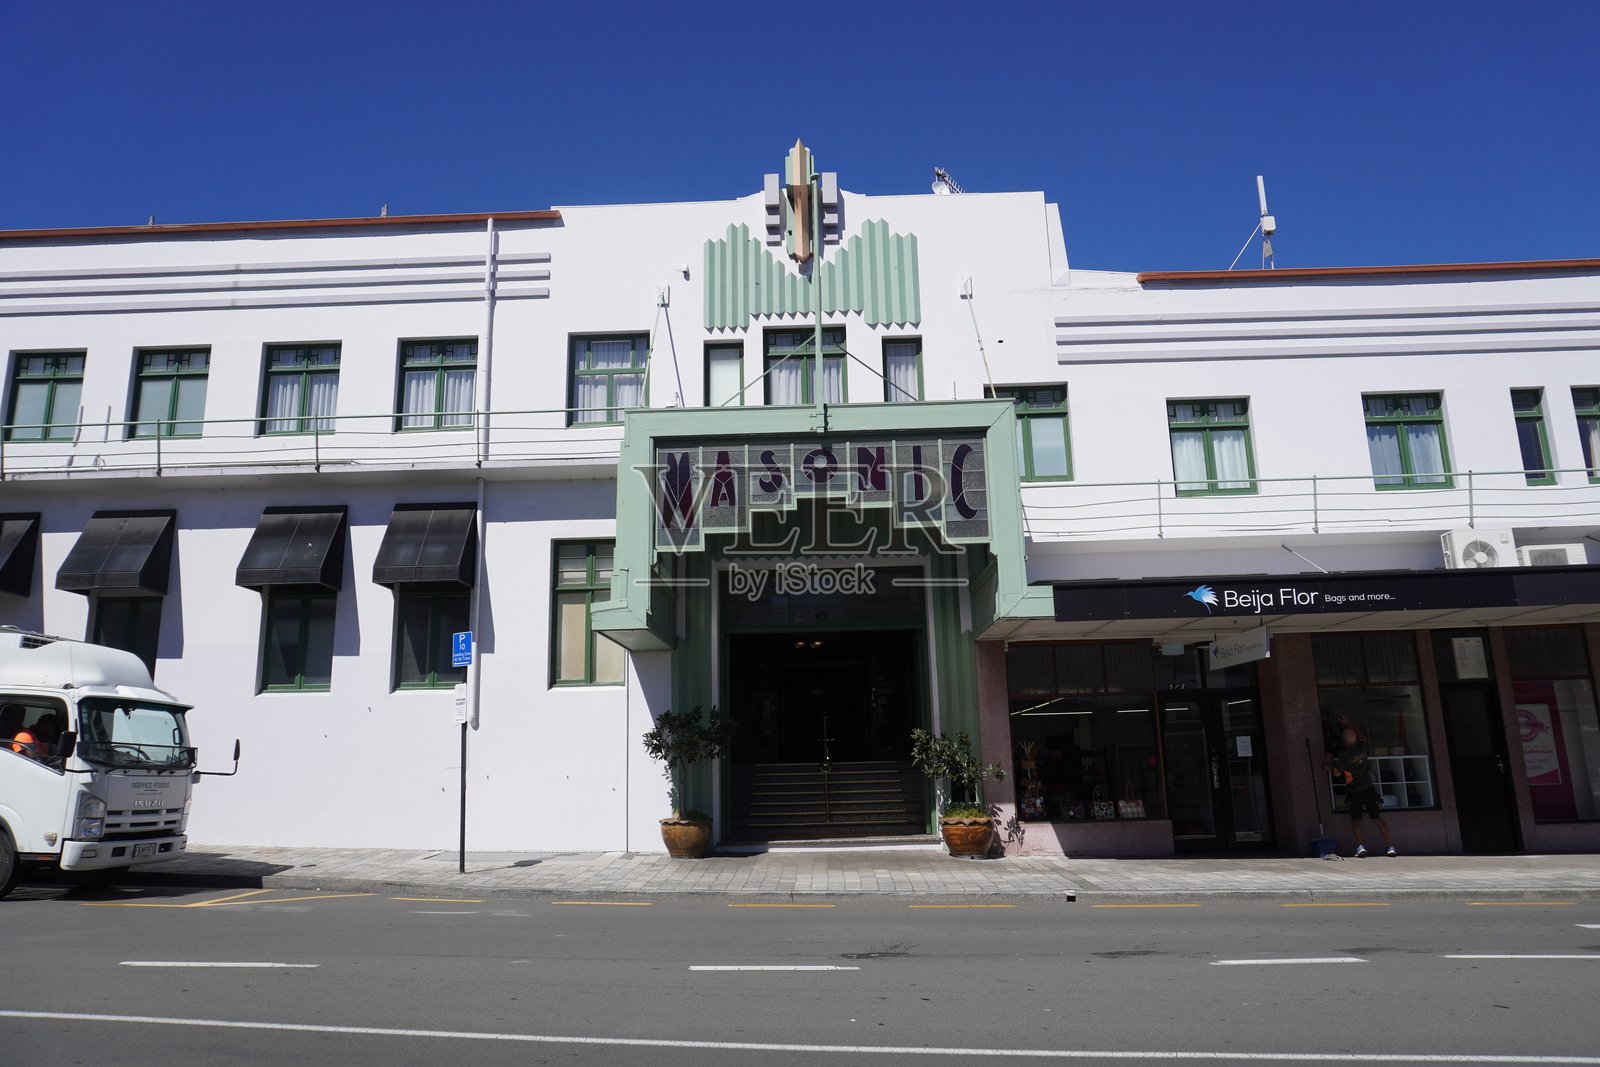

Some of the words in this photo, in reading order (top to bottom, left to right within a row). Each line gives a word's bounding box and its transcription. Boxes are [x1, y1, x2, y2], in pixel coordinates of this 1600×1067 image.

[661, 443, 978, 530] MASONIC
[1224, 590, 1274, 613] Beija
[1279, 588, 1319, 606] Flor
[1324, 594, 1346, 604] Bags
[1348, 594, 1365, 602] and
[1367, 592, 1396, 601] more...
[459, 634, 466, 644] P
[459, 643, 466, 651] 10
[134, 799, 165, 808] ISUZU
